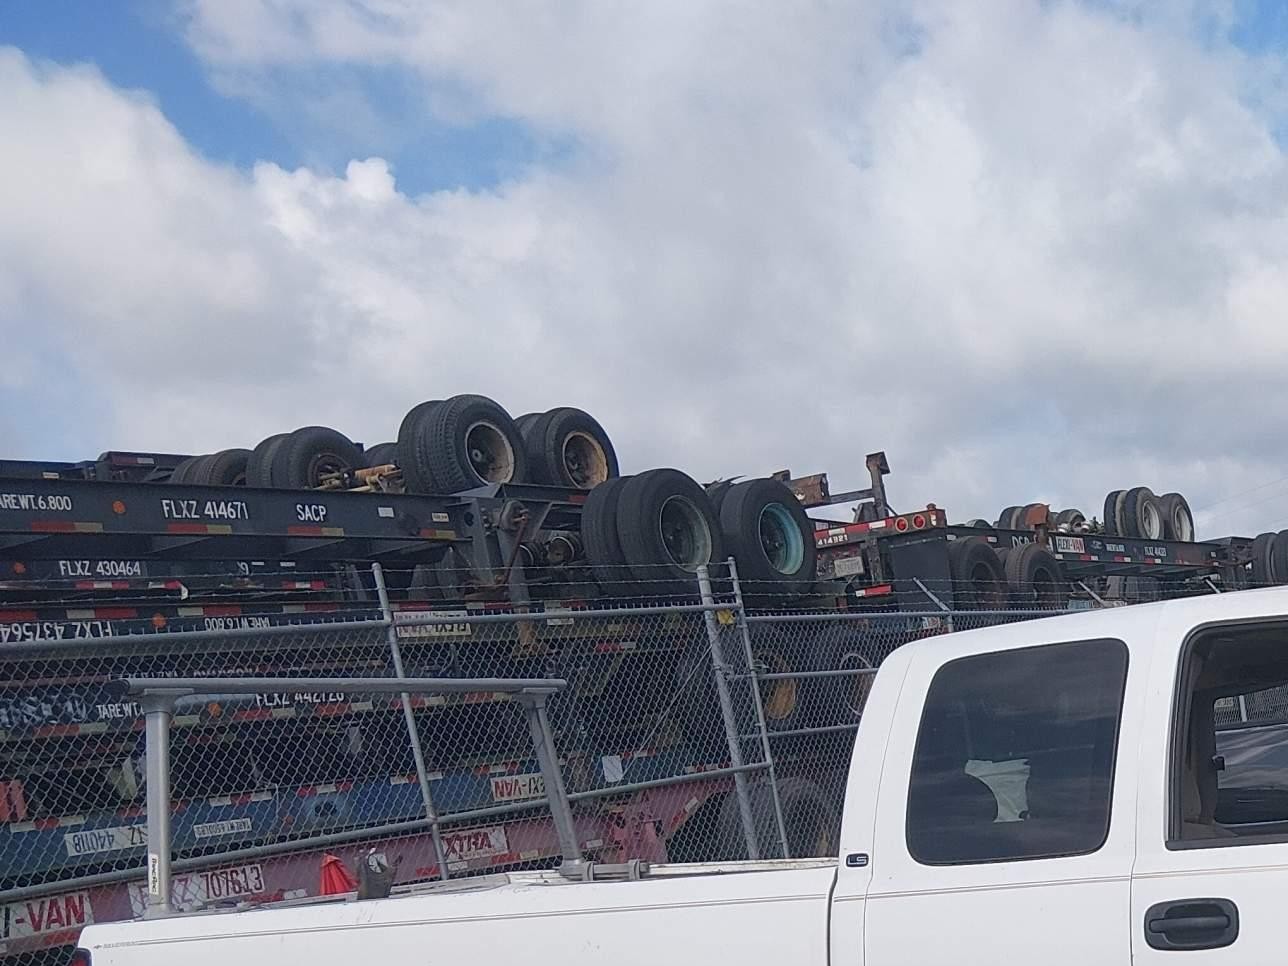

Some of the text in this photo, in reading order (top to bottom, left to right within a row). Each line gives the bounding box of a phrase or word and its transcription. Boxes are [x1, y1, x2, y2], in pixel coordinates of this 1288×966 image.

[161, 499, 249, 520] FLXZ 414671
[296, 504, 327, 521] SACP
[58, 560, 141, 576] FLXZ 430464
[74, 620, 113, 639] FLXZ
[847, 856, 868, 866] LS
[200, 865, 264, 900] 707613
